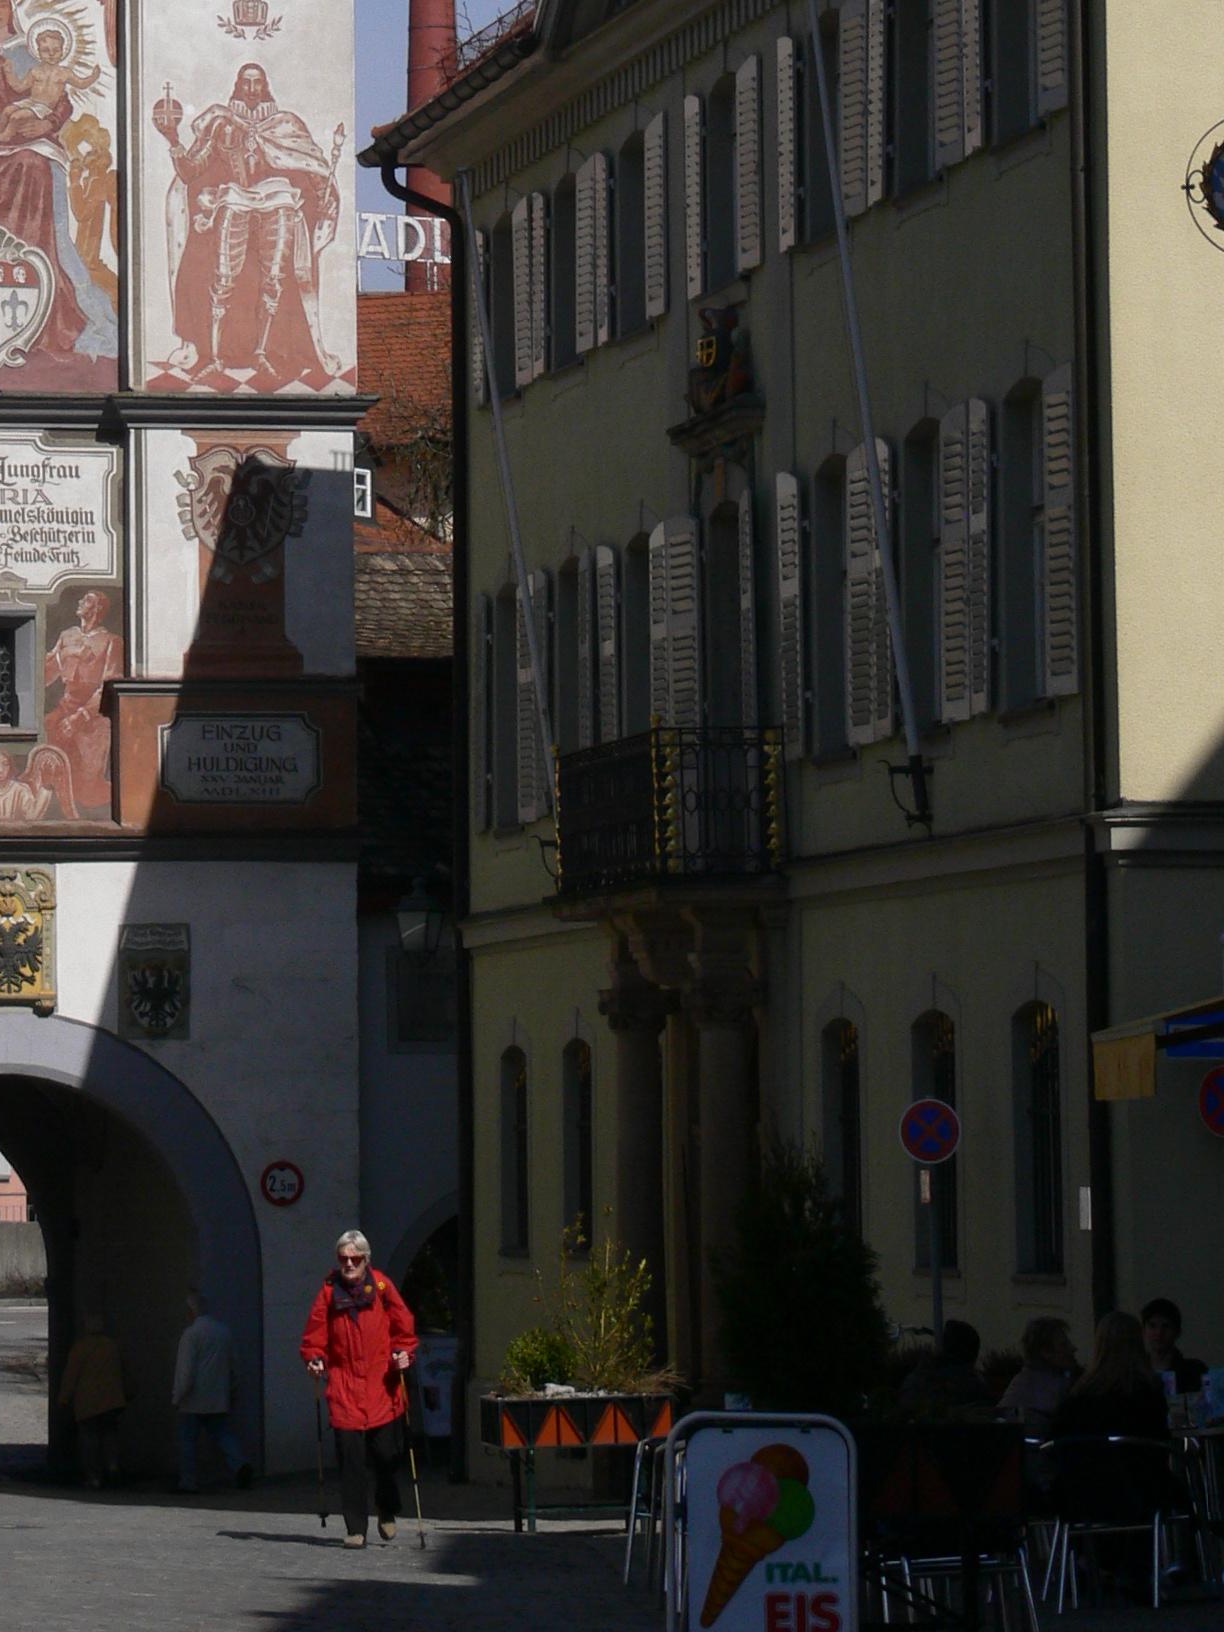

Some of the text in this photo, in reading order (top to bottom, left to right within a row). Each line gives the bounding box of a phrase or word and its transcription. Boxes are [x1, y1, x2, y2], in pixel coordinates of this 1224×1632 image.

[6, 525, 96, 548] Beschützerin
[201, 724, 281, 742] EINZUG
[223, 742, 258, 754] UND
[187, 756, 298, 774] HULDIGUNG
[233, 775, 285, 785] JANUAR
[765, 1562, 839, 1584] ITAL.
[765, 1591, 841, 1632] EIS
